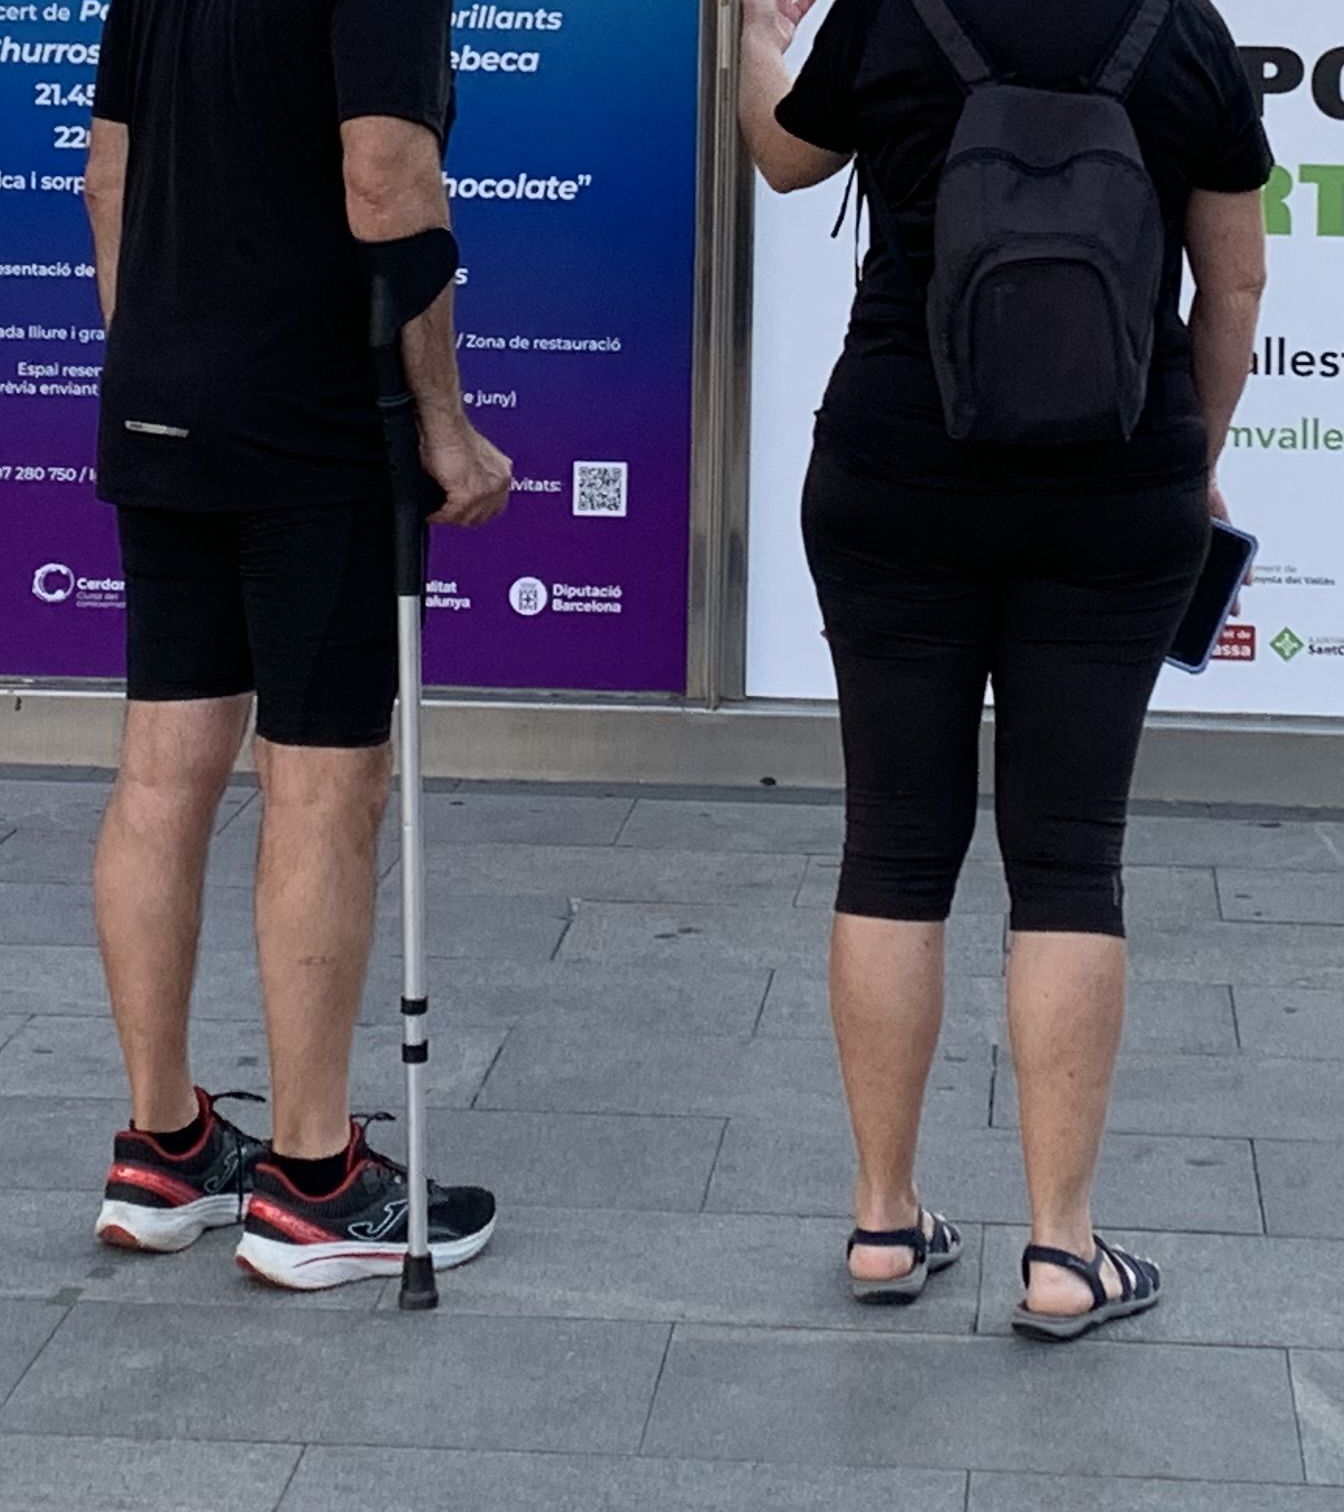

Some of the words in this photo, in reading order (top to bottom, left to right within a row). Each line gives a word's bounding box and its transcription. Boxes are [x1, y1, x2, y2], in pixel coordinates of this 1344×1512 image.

[42, 3, 71, 22] de
[30, 171, 37, 190] i
[74, 263, 96, 278] de
[28, 325, 67, 341] lliure
[466, 335, 506, 350] Zona
[509, 335, 530, 350] de
[533, 336, 622, 353] restauració
[40, 382, 99, 397] enviant
[476, 391, 517, 407] juny)
[15, 467, 45, 481] 280
[48, 468, 76, 482] 750
[553, 584, 622, 599] Diputació
[552, 599, 622, 613] Barcelona
